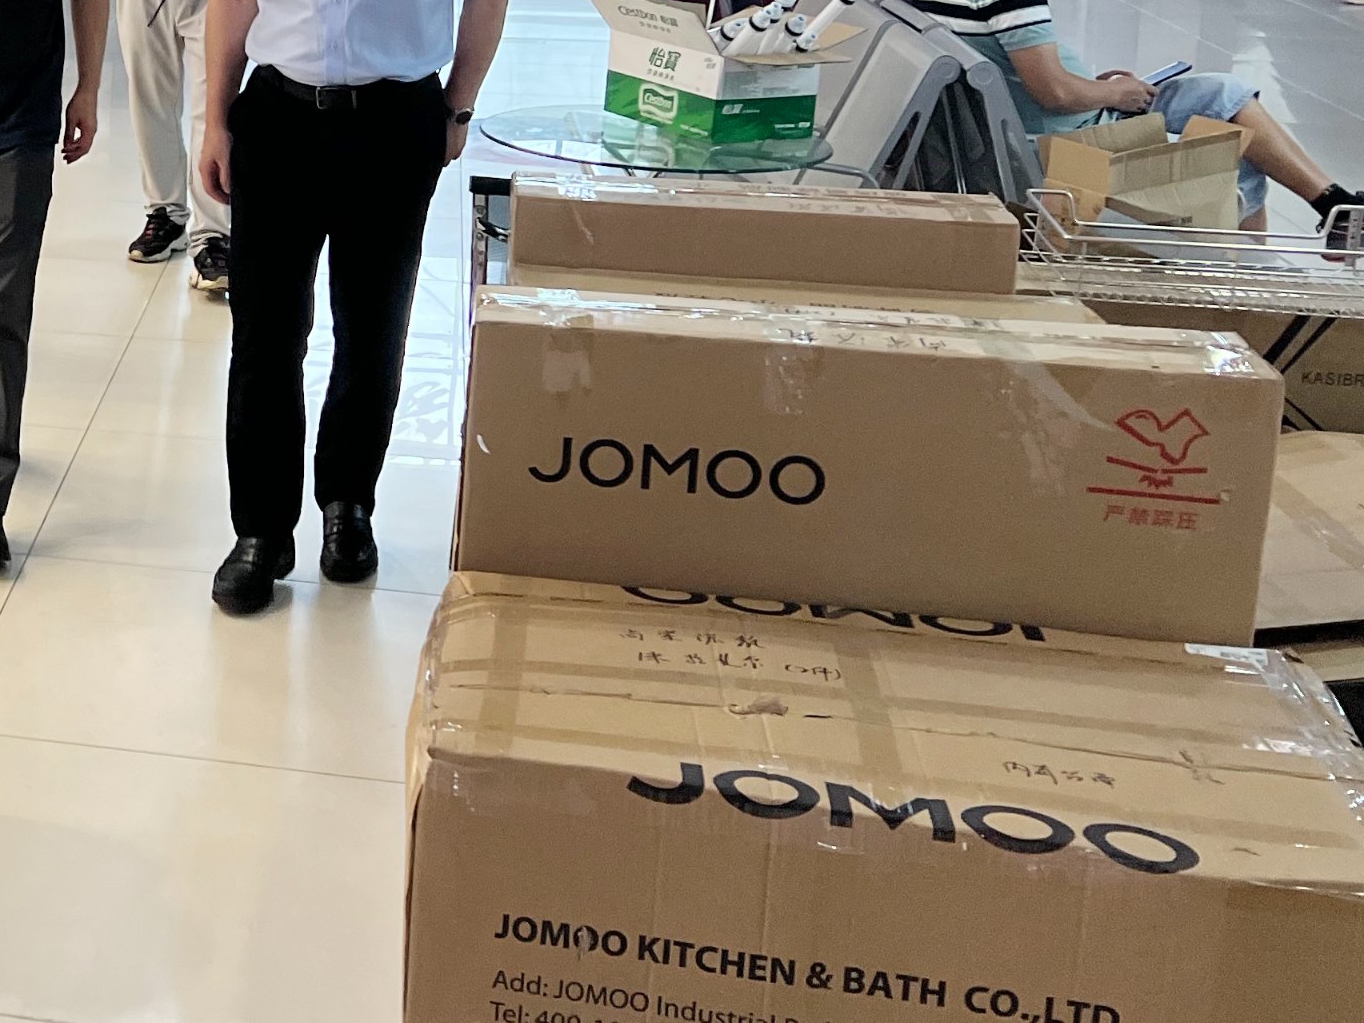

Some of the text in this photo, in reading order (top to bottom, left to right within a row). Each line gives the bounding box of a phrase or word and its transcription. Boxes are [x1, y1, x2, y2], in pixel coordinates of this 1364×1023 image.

[528, 437, 826, 506] JOMOO
[627, 762, 1201, 876] JOMOO
[494, 913, 629, 958] JOMOO
[636, 934, 797, 987] KITCHEN
[804, 961, 835, 990] &
[842, 966, 947, 1009] BATH
[488, 1000, 532, 1023] Tel:
[492, 969, 779, 1023] Add: JOMOO Industrial
